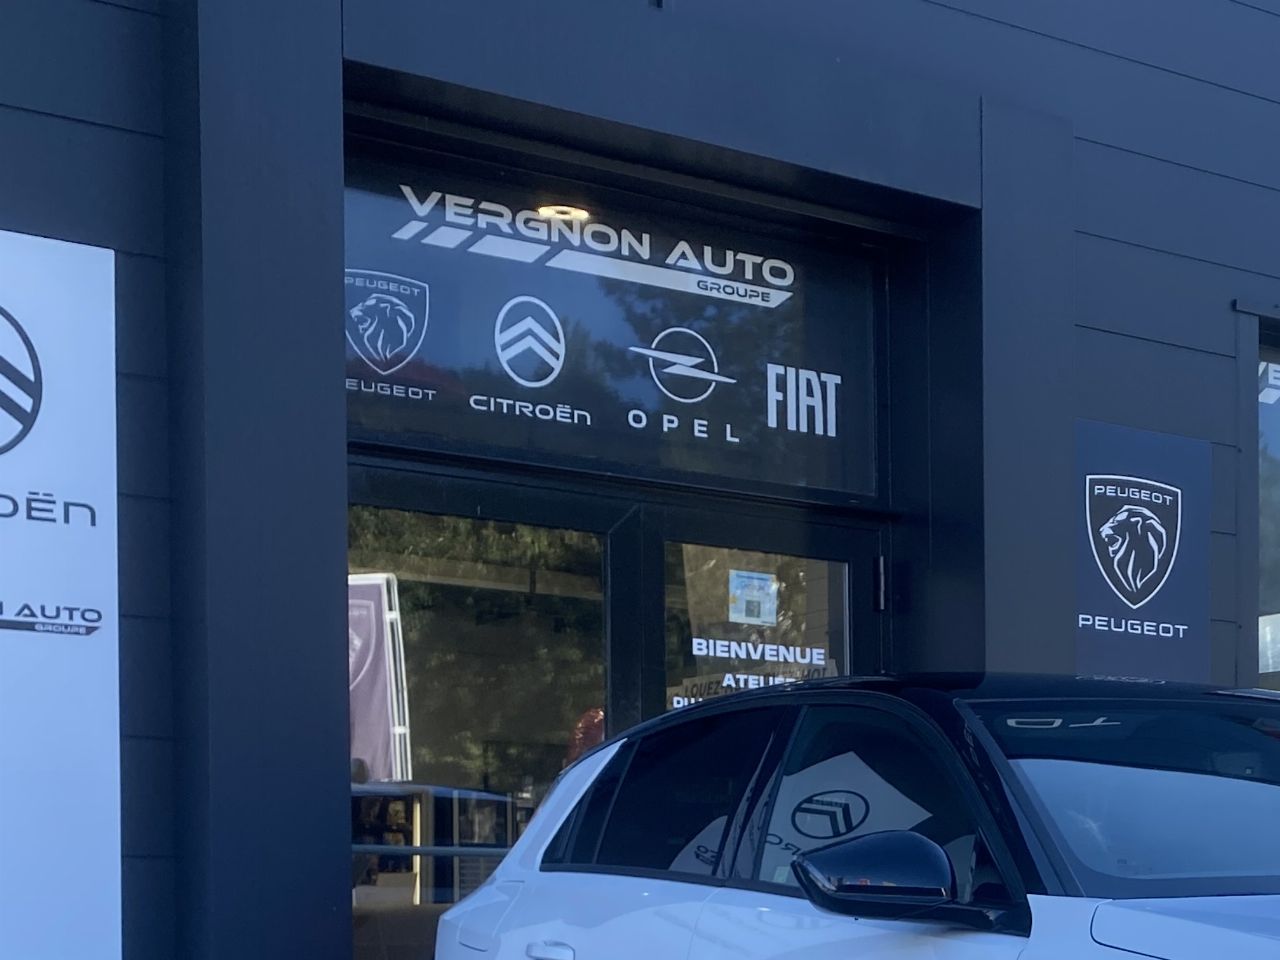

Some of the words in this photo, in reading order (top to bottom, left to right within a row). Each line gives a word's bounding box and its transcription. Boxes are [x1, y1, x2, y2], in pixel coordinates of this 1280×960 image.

[399, 184, 651, 260] VERGNON
[665, 239, 795, 287] AUTO
[345, 276, 421, 296] PEUGEOT
[696, 279, 771, 302] GROUPE
[345, 378, 437, 401] EUGEOT
[766, 362, 842, 438] FIAT
[627, 409, 740, 442] OPEL
[1093, 485, 1174, 506] PEUGEOT
[14, 602, 103, 623] AUTO
[1078, 613, 1189, 639] PEUGEOT
[691, 636, 826, 666] BIENVENUE
